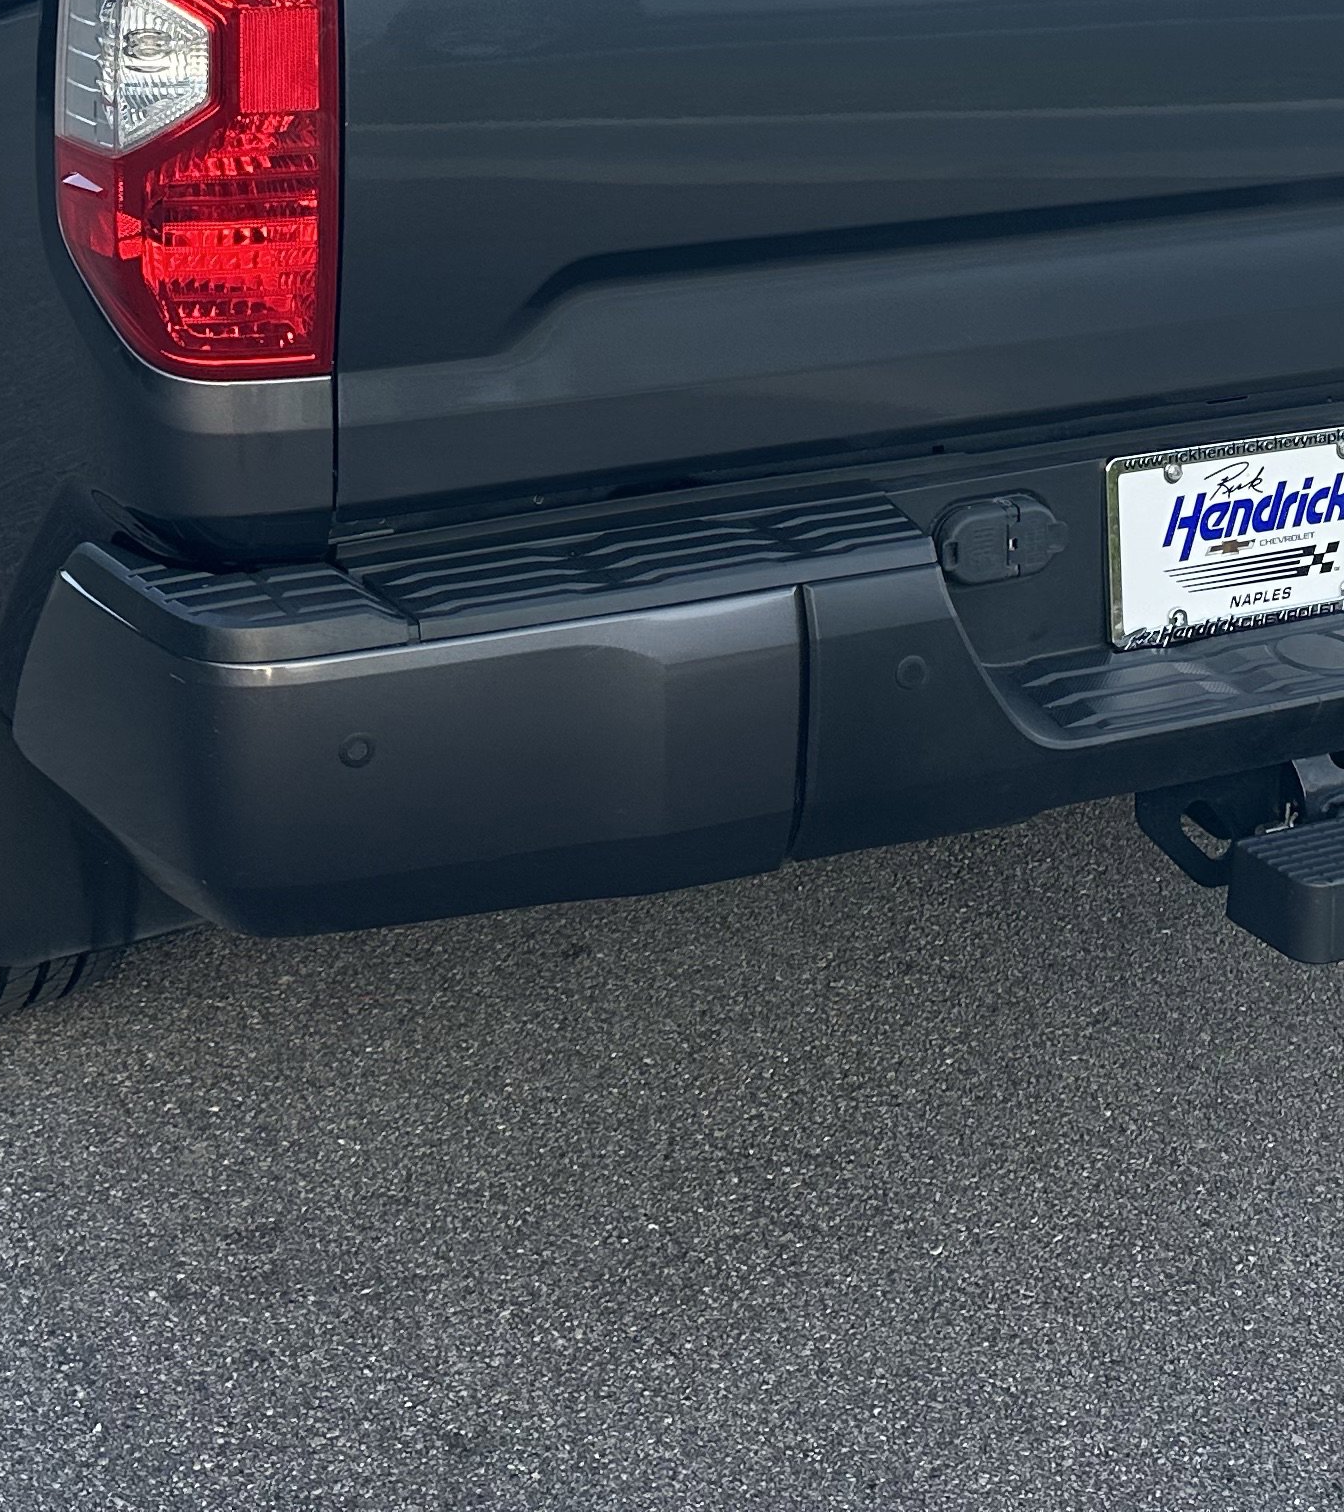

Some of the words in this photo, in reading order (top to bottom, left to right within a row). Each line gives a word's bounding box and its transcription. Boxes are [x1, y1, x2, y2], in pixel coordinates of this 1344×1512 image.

[1259, 531, 1315, 547] CHEVROLET
[1229, 586, 1292, 610] NAPLES
[1237, 602, 1338, 628] CHEVROLET
